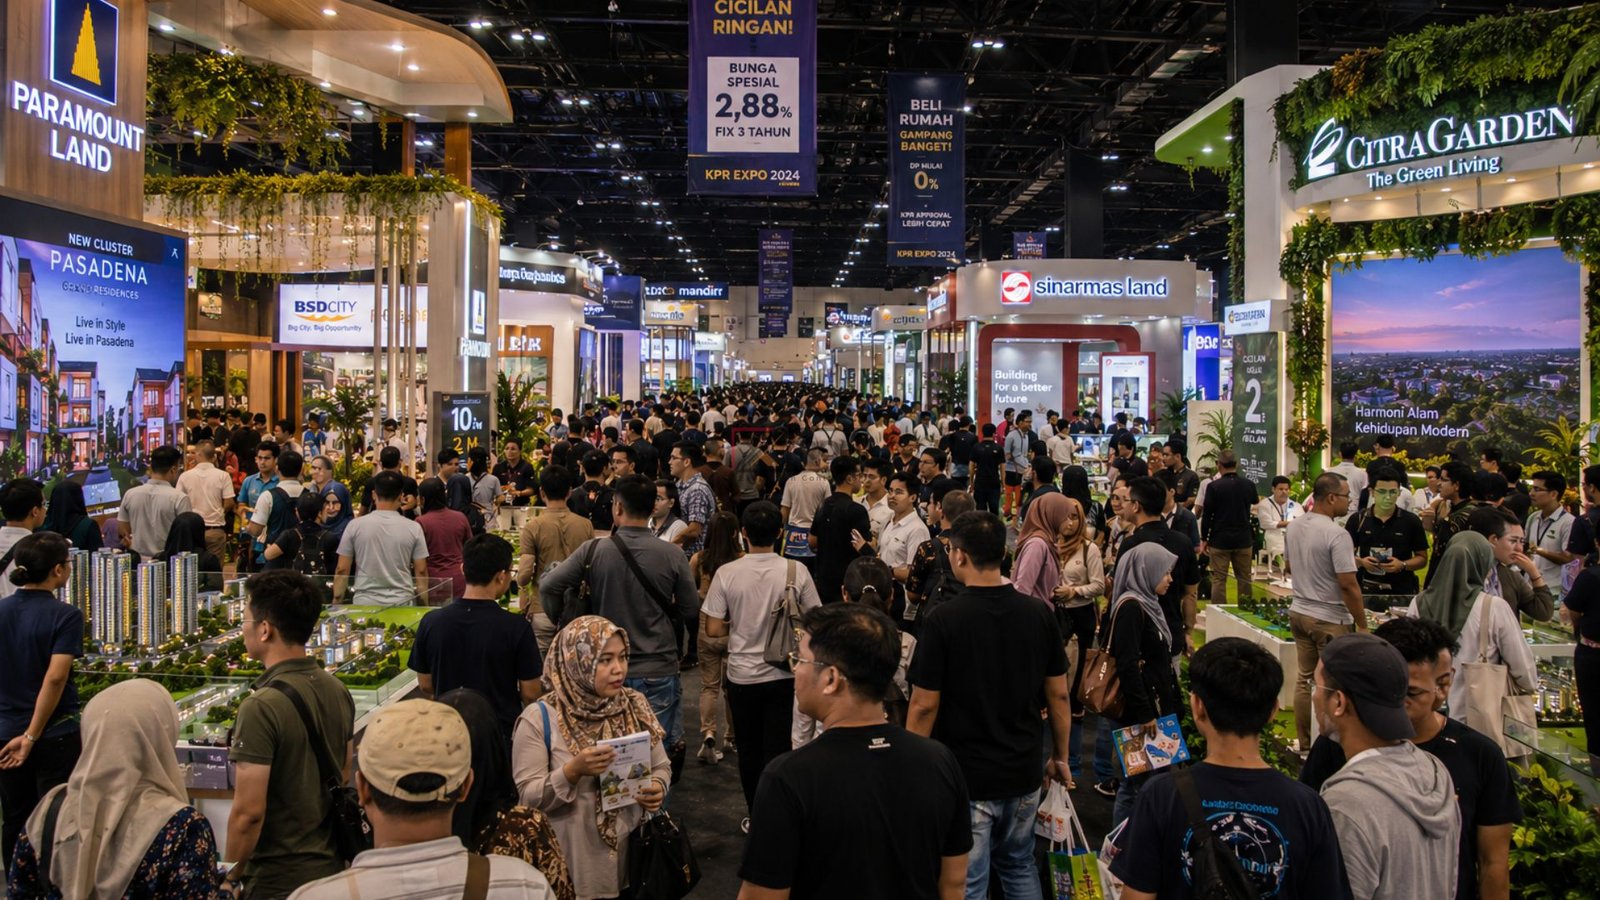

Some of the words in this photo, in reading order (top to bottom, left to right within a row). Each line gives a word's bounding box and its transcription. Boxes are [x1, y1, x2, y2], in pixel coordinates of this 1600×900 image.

[714, 0, 792, 15] CICILAN
[713, 19, 793, 35] RINGAN!
[729, 63, 777, 74] BUNGA
[727, 77, 779, 88] SPESIAL
[715, 93, 792, 123] 2,88%
[911, 99, 941, 111] BELI
[12, 80, 144, 152] PARAMOUNT
[900, 114, 953, 126] RUMAH
[715, 127, 734, 137] FIX
[738, 127, 745, 137] 3
[749, 127, 791, 137] TAHUN
[900, 130, 953, 140] GAMPANG
[50, 129, 112, 173] LAND
[901, 141, 952, 151] BANGET!
[705, 169, 731, 180] KPR
[734, 169, 768, 180] EXPO
[770, 170, 800, 180] 2024
[1367, 172, 1393, 188] The
[1397, 166, 1444, 184] Green
[1449, 156, 1500, 176] Living
[914, 171, 939, 190] 0%
[68, 233, 91, 247] NEW
[94, 239, 134, 256] CLUSTER
[51, 250, 148, 285] PASADENA
[1035, 277, 1123, 296] sinarmas
[1128, 278, 1167, 296] land
[294, 300, 357, 313] BSDCITY
[76, 316, 94, 328] Live
[95, 317, 104, 329] in
[106, 319, 126, 333] Style
[65, 332, 83, 345] Live
[86, 334, 94, 345] in
[96, 335, 134, 348] Pasadena
[995, 370, 1038, 382] Building
[995, 382, 1009, 392] for
[1021, 382, 1053, 392] better
[995, 394, 1028, 403] future
[1245, 378, 1262, 423] 2
[451, 406, 473, 431] 10
[1355, 406, 1404, 418] Harmoni
[1407, 407, 1439, 419] Alam
[1355, 421, 1417, 437] Kehidupan
[1421, 425, 1469, 438] Modern
